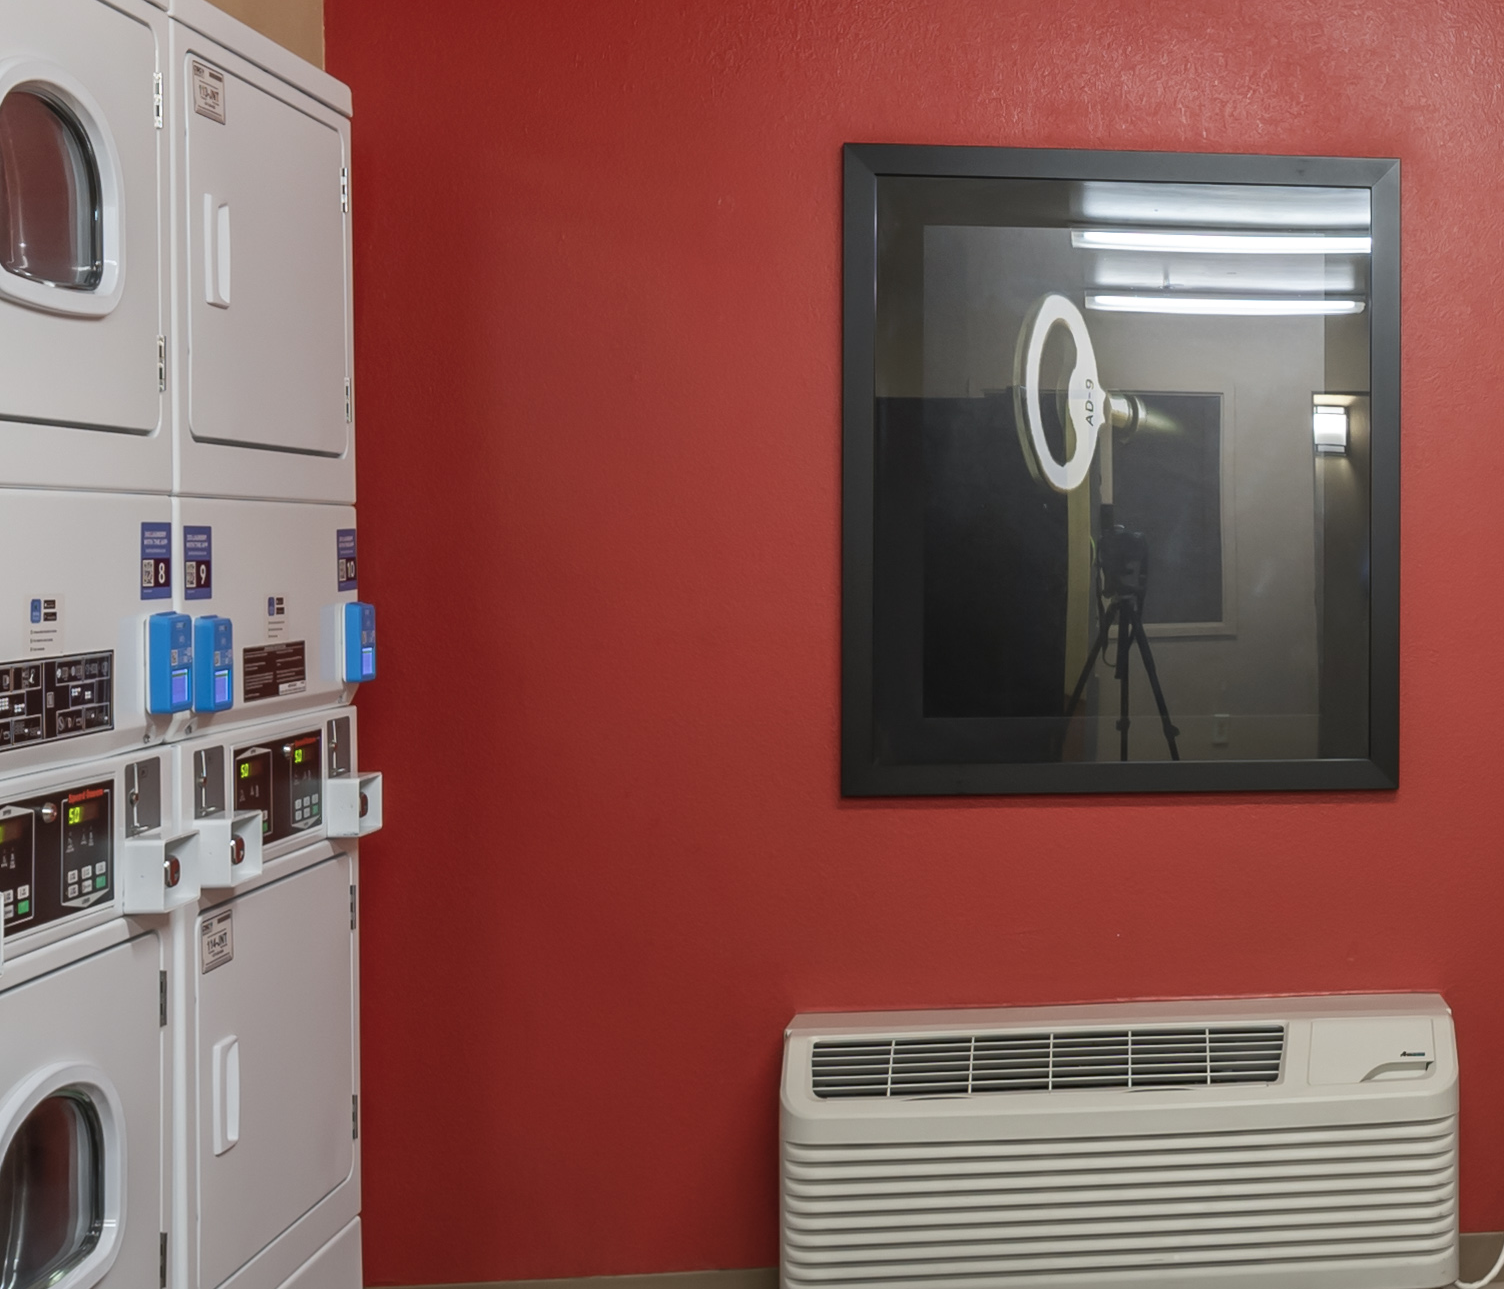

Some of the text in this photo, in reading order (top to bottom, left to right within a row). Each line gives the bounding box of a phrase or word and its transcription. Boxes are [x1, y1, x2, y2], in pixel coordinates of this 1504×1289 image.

[158, 562, 165, 584] 8
[199, 563, 207, 585] 9
[347, 560, 355, 579] 10
[68, 807, 81, 825] 50
